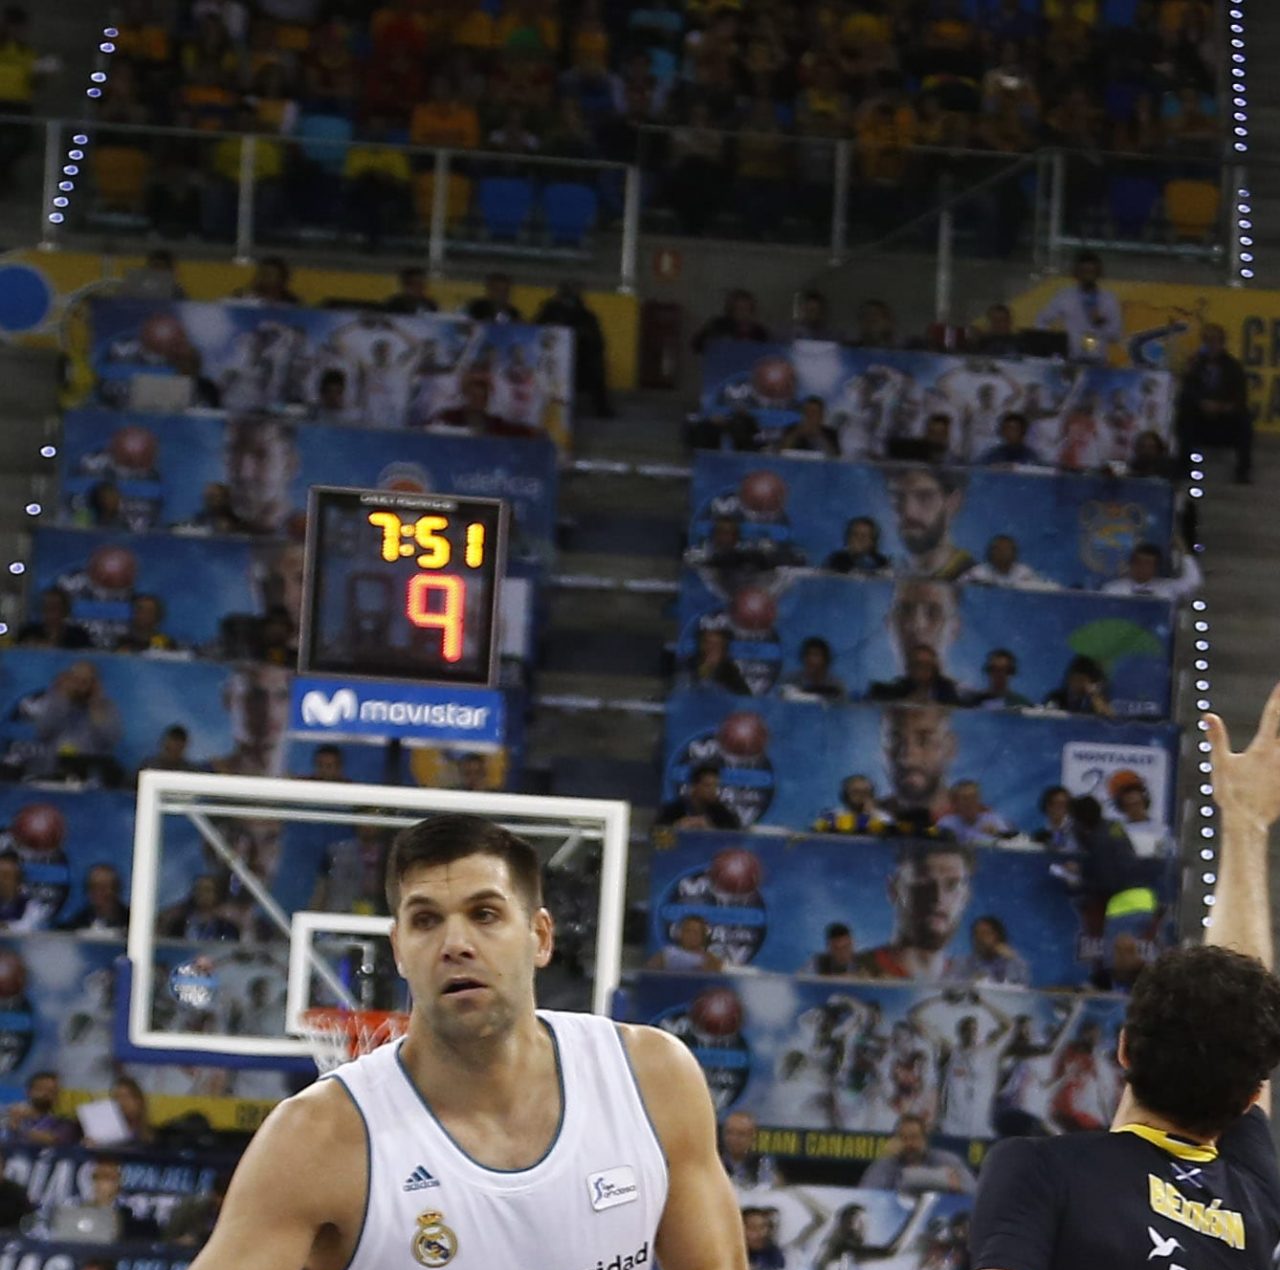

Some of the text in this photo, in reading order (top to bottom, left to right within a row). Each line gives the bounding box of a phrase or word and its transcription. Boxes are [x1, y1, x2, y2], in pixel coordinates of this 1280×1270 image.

[369, 511, 486, 569] 7:51
[407, 573, 466, 663] 9
[360, 699, 490, 730] movistar
[755, 1129, 798, 1156] RAN
[403, 1179, 441, 1192] adidas
